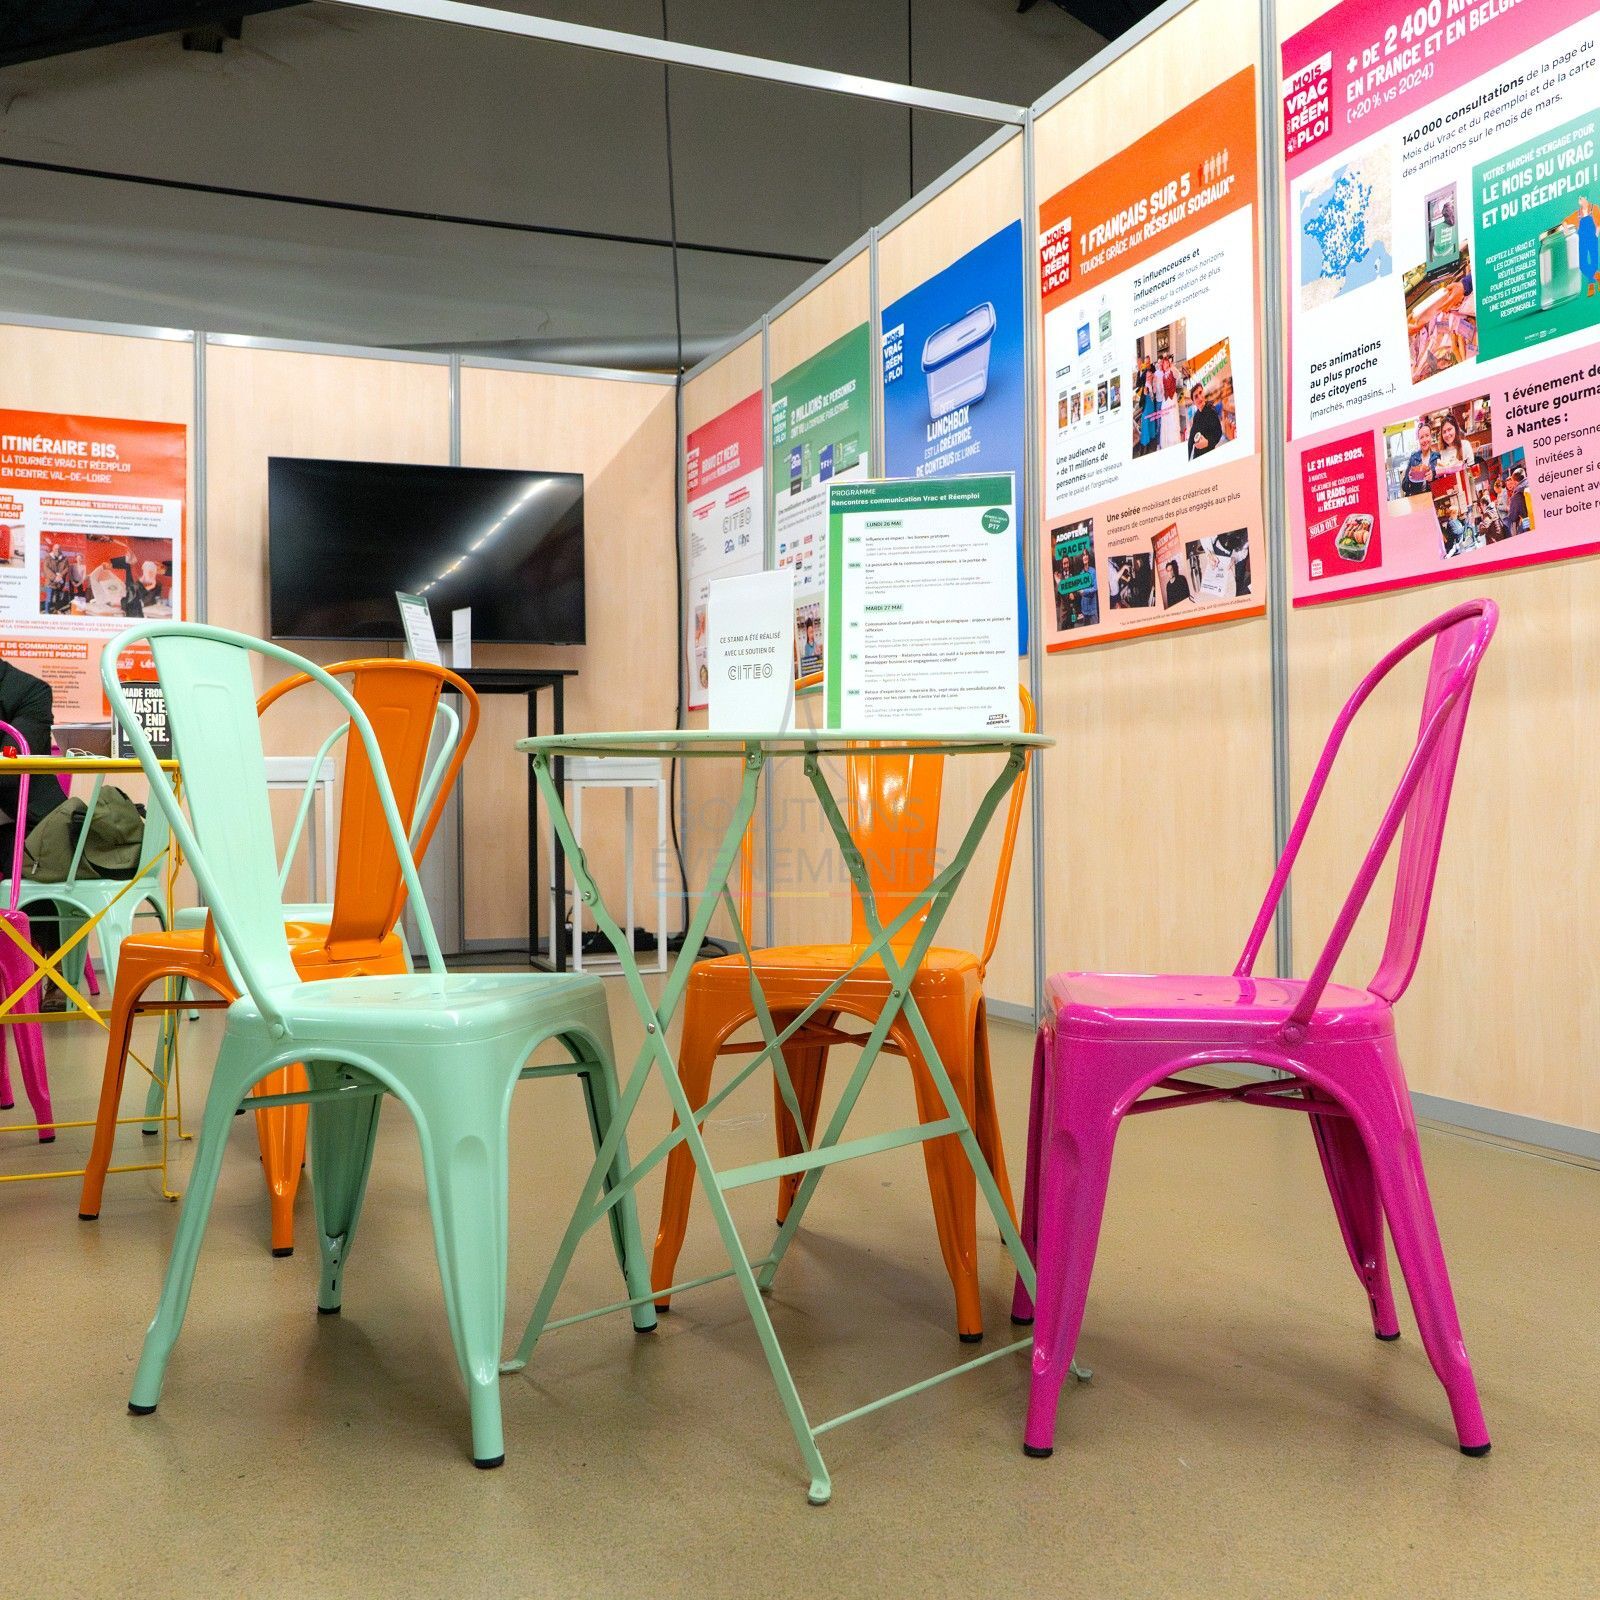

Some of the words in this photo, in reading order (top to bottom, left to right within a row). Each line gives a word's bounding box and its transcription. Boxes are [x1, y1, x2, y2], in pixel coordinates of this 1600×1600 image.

[1346, 75, 1364, 104] EN
[1366, 42, 1422, 92] FRANCE
[1424, 29, 1444, 57] ET
[1446, 16, 1466, 46] EN
[1362, 42, 1381, 69] DE
[1292, 63, 1322, 92] MOIS
[1383, 85, 1397, 103] vs
[1399, 61, 1434, 95] 2024)
[1286, 77, 1328, 115] VRAC
[1402, 128, 1420, 146] 140
[1421, 117, 1443, 136] 000
[1445, 75, 1524, 123] consultations
[1526, 69, 1539, 81] de
[1541, 63, 1550, 75] la
[1552, 48, 1578, 70] page
[1580, 39, 1594, 53] du
[1291, 97, 1329, 133] RÉEM
[1402, 146, 1422, 163] Mois
[1423, 140, 1435, 152] du
[1436, 129, 1456, 144] Vrac
[1457, 123, 1467, 134] et
[1469, 116, 1481, 128] du
[1530, 86, 1540, 97] et
[1542, 78, 1555, 90] de
[1557, 72, 1566, 83] la
[1568, 57, 1596, 78] carte
[1297, 116, 1329, 148] PLOI
[1402, 165, 1417, 178] des
[1418, 140, 1467, 170] animations
[1468, 132, 1483, 146] sur
[1484, 127, 1493, 137] le
[1495, 114, 1518, 132] mois
[1520, 107, 1533, 119] de
[1535, 93, 1563, 112] mars.
[1483, 164, 1505, 182] VOTRE
[1506, 148, 1535, 171] MARCHÉ
[1535, 133, 1572, 158] S'ENGAGE
[1572, 122, 1595, 141] POUR
[1482, 182, 1499, 205] LE
[1501, 168, 1533, 197] MOIS
[1536, 158, 1555, 181] DU
[1557, 140, 1594, 171] VRAC
[1482, 207, 1499, 230] ET
[1500, 198, 1519, 222] DU
[1521, 167, 1590, 213] RÉEMPLOI
[1079, 234, 1086, 255] 1
[1088, 198, 1148, 252] FRANÇAIS
[1150, 180, 1178, 216] SUR
[1180, 172, 1191, 198] 5
[1041, 237, 1069, 263] VRAC
[1079, 247, 1106, 276] TOUCHÉ
[1106, 237, 1129, 261] GRÂCE
[1129, 229, 1143, 253] AUX
[1144, 203, 1186, 240] RÉSEAUX
[1045, 252, 1070, 277] RÉEM
[1133, 278, 1142, 289] 75
[1142, 254, 1191, 284] influenceuses
[1192, 248, 1200, 258] et
[1048, 268, 1070, 292] PLOI
[1133, 274, 1176, 301] influenceurs
[883, 339, 904, 358] VRAC
[886, 352, 903, 370] RÉEM
[1310, 361, 1327, 374] Des
[1329, 340, 1382, 367] animations
[888, 365, 903, 383] PLOI
[1310, 378, 1321, 389] au
[1323, 370, 1343, 387] plus
[1344, 357, 1378, 378] proche
[1310, 391, 1326, 404] des
[1328, 377, 1367, 397] citoyens
[1504, 391, 1509, 403] 1
[1512, 369, 1584, 401] événement
[1505, 399, 1550, 420] clôture
[926, 404, 970, 443] LUNCHBOX
[1506, 425, 1513, 438] à
[1517, 414, 1561, 436] Nantes
[2, 434, 89, 456] ITINÉRAIRE
[91, 441, 120, 460] BIS,
[939, 425, 972, 453] CRÉATRICE
[1532, 436, 1551, 449] 500
[1, 454, 13, 464] LA
[14, 455, 53, 467] TOURNÉE
[54, 458, 77, 469] VRAC
[77, 460, 89, 470] ET
[90, 460, 131, 473] RÉEMPLOI
[924, 450, 955, 475] CONTENUS
[1307, 461, 1317, 473] LE
[1317, 459, 1325, 470] 31
[1325, 453, 1343, 467] MARS
[1535, 451, 1575, 467] invitées
[1577, 446, 1583, 456] à
[1, 467, 13, 477] EN
[15, 468, 49, 480] CENTRE
[50, 471, 112, 484] VAL-DE-LOIRE
[1537, 466, 1584, 484] déjeuner
[1585, 461, 1594, 473] si
[831, 488, 877, 497] PROGRAMME
[831, 499, 869, 507] Rencontres
[870, 495, 922, 505] communication
[922, 494, 938, 502] Vrac
[948, 492, 980, 502] Réemploi
[1540, 483, 1585, 501] venaient
[1106, 513, 1120, 523] Une
[1120, 506, 1141, 519] soirée
[1141, 499, 1171, 512] mobilisant
[1171, 495, 1182, 504] des
[1182, 487, 1211, 501] créatrices
[1543, 506, 1563, 519] leur
[1565, 501, 1592, 516] boite
[722, 506, 752, 534] CITEO
[987, 522, 1000, 530] P17
[1309, 521, 1325, 537] SOLD
[1325, 517, 1338, 531] OUT
[19, 643, 87, 651] COMMUNICATION
[727, 635, 744, 643] STAND
[749, 632, 759, 641] ÉTÉ
[759, 630, 781, 640] RÉALISÉ
[19, 651, 54, 659] IDENTITÉ
[55, 651, 87, 660] PROPRE
[745, 647, 768, 656] SOUTIEN
[727, 663, 773, 681] CITEO
[122, 687, 144, 698] MADE
[145, 714, 166, 727] END
